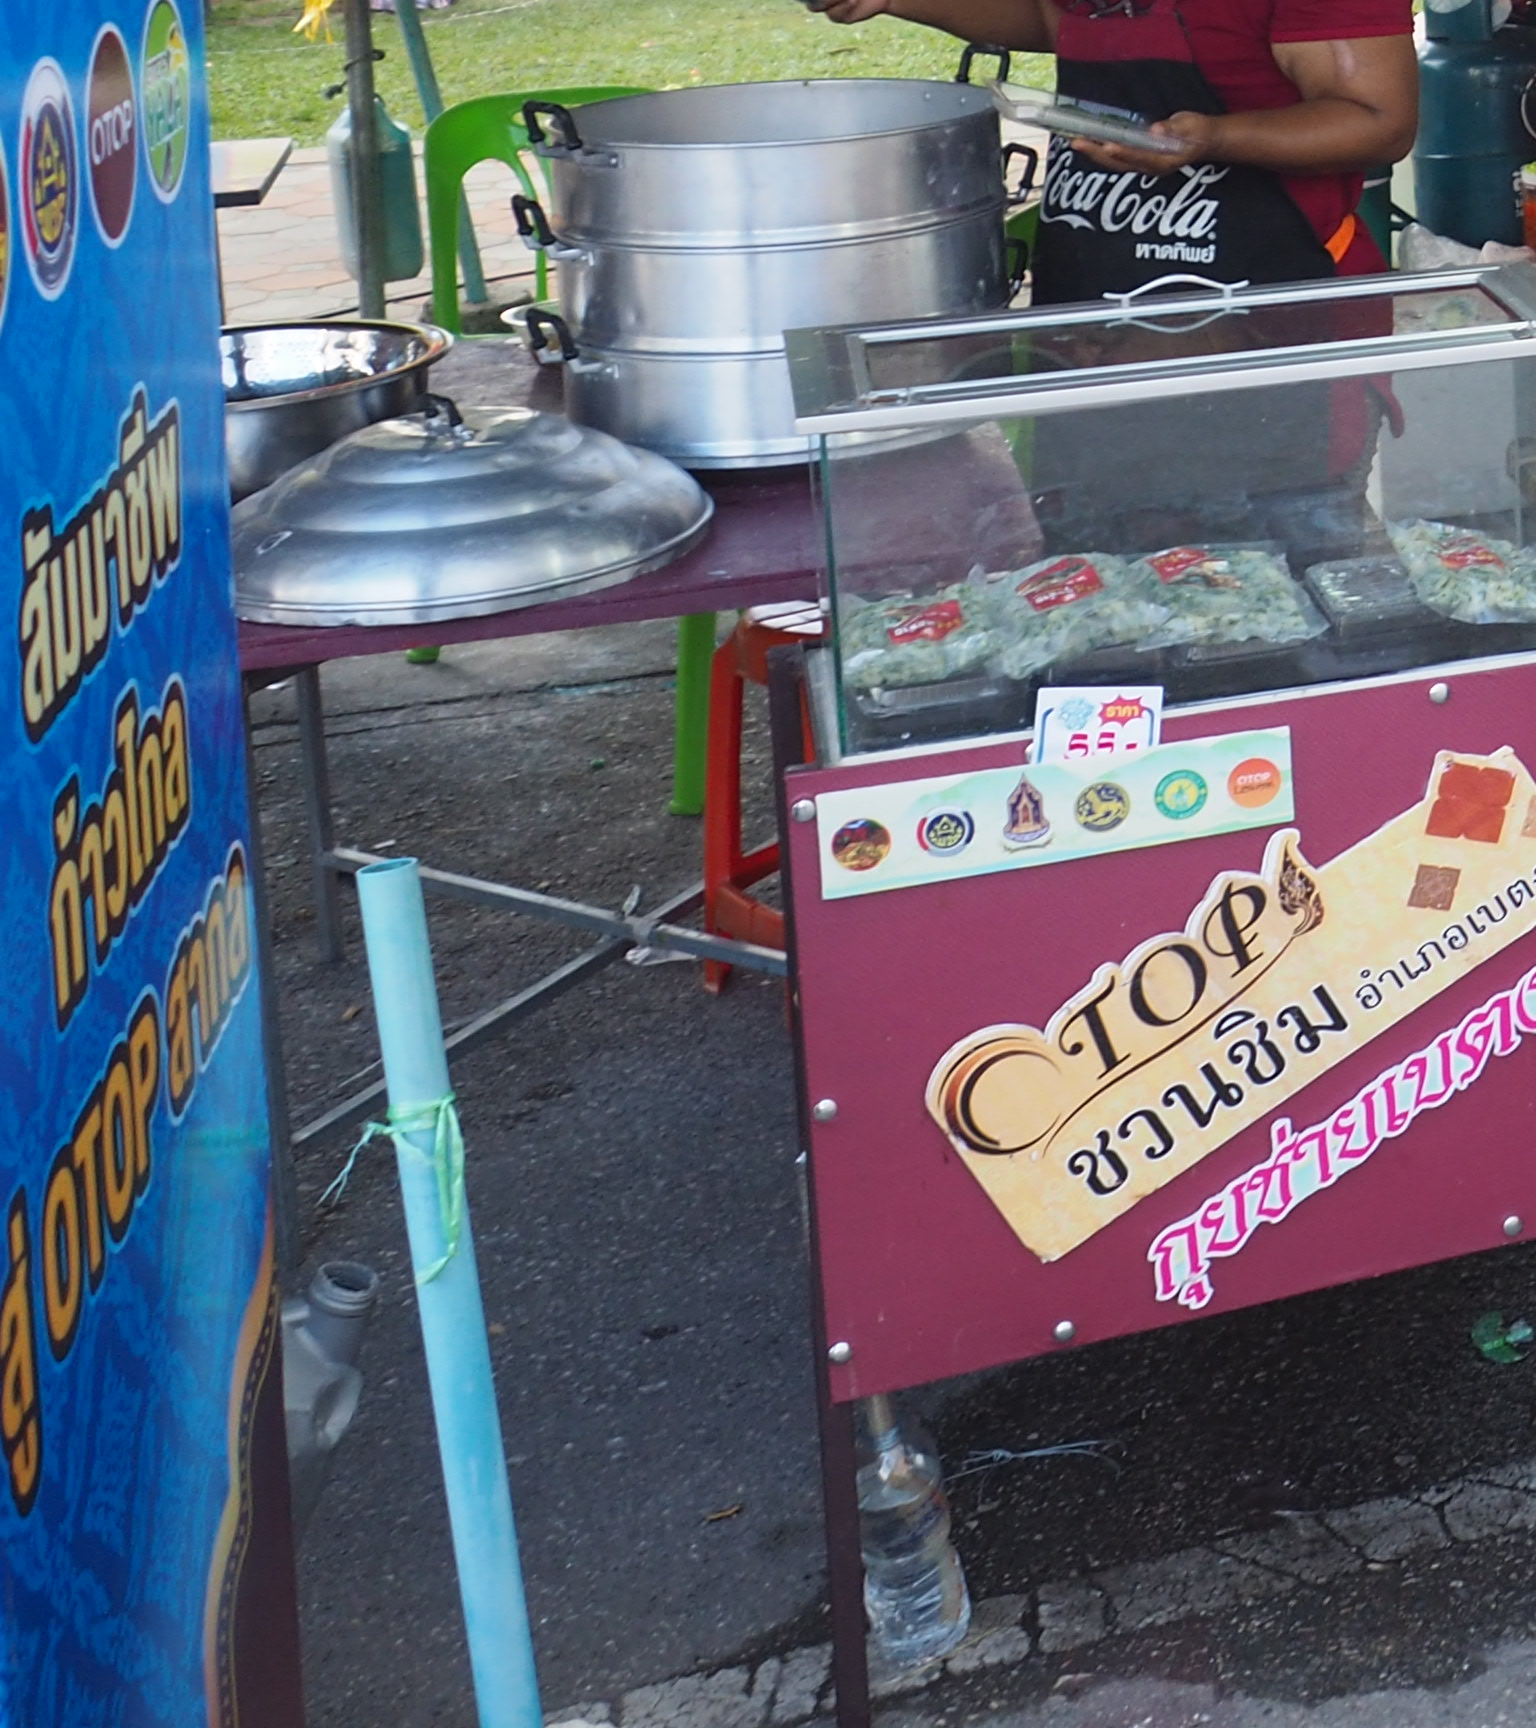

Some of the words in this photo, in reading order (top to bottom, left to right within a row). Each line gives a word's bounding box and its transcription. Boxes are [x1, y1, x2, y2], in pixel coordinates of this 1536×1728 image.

[92, 100, 133, 165] OTOP
[1040, 151, 1229, 239] Coca-Cola
[1135, 242, 1217, 264] หาดทิพย์
[21, 390, 180, 742] สัมมาชีพ
[1104, 705, 1139, 719] ราคา
[50, 687, 190, 1030] ก้าวไกล
[1066, 985, 1350, 1197] ชวนชิม
[0, 1189, 41, 1515] สู่
[42, 992, 159, 1359] OTOP
[166, 849, 249, 1118] สากล
